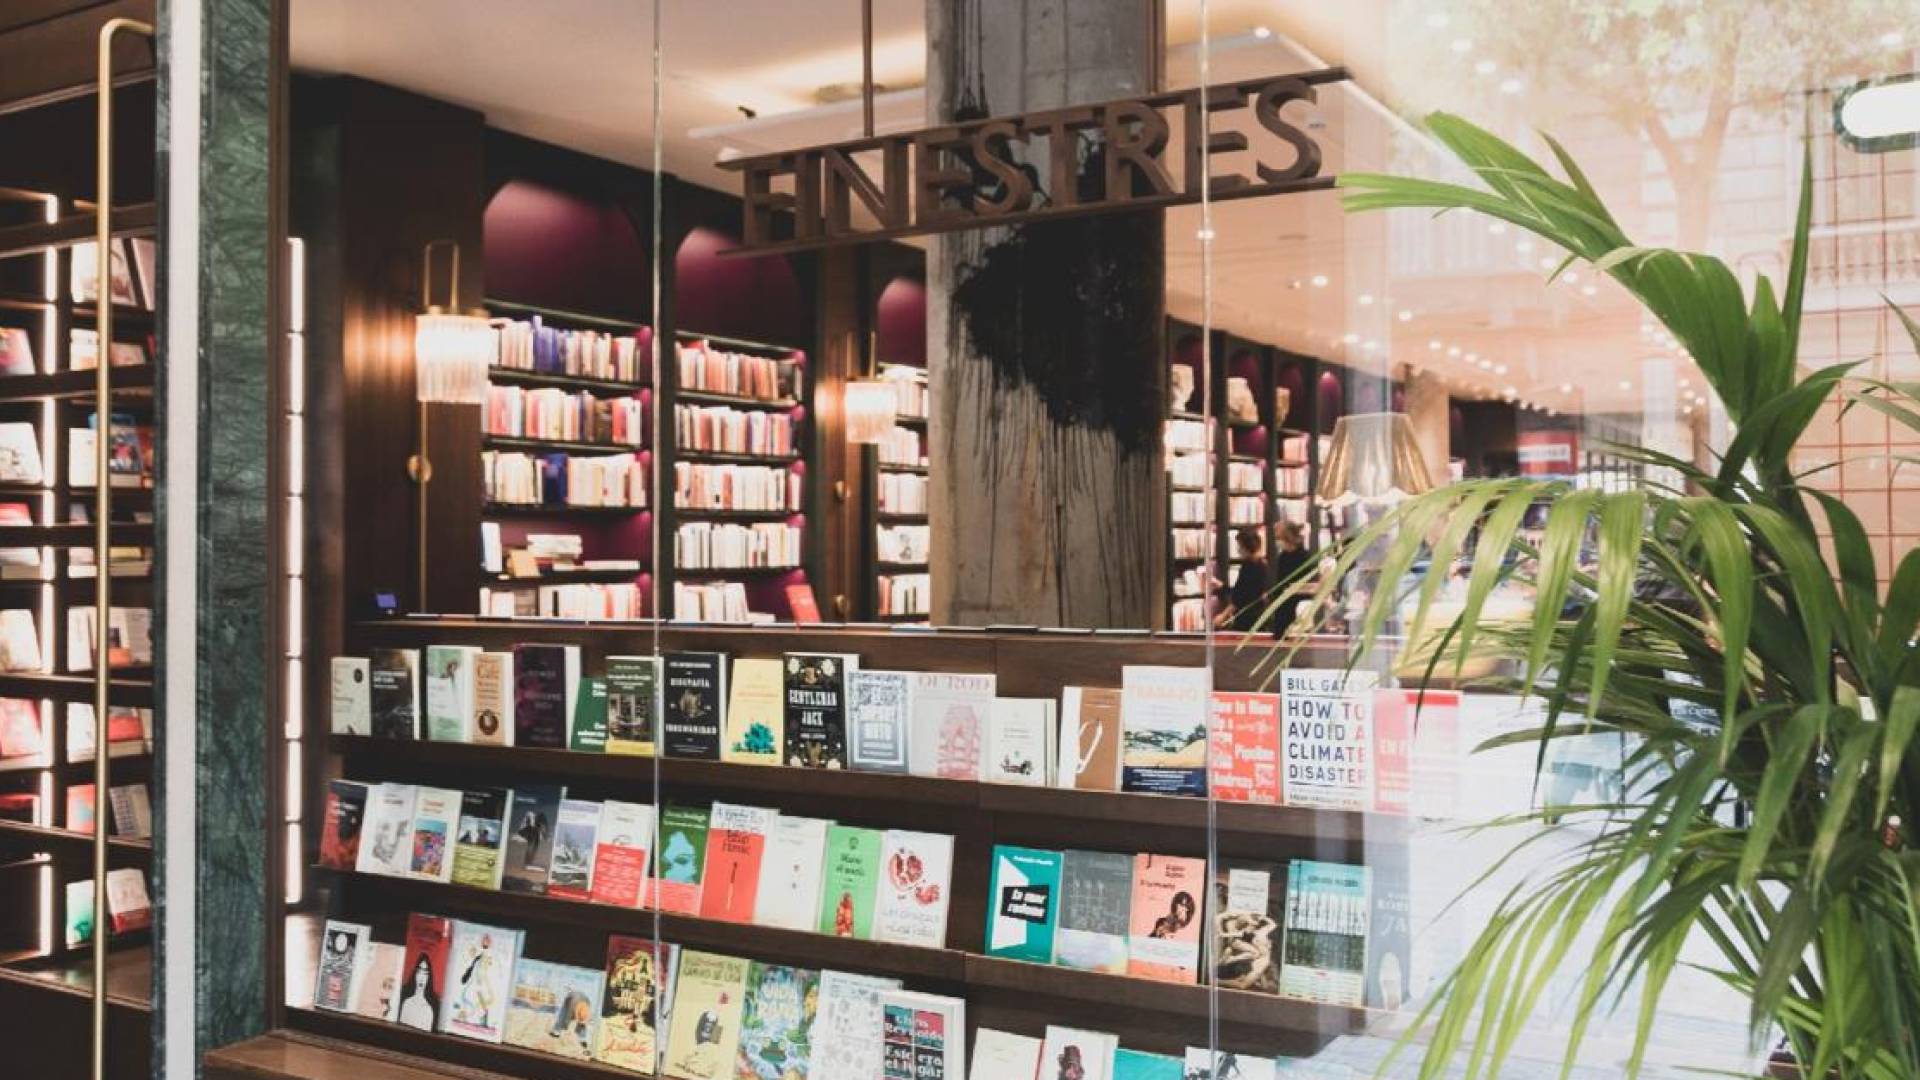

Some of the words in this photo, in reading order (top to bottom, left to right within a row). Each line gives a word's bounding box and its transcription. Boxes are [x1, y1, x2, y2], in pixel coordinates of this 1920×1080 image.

[743, 77, 1323, 246] FINESTRES
[1287, 677, 1317, 692] BILL
[801, 710, 824, 727] JACK
[1287, 700, 1333, 719] HOW
[1340, 702, 1365, 721] TO
[1287, 721, 1346, 741] AVOID
[1354, 726, 1365, 741] A
[1288, 742, 1366, 764] CLIMATE
[1288, 764, 1367, 785] DISASTER
